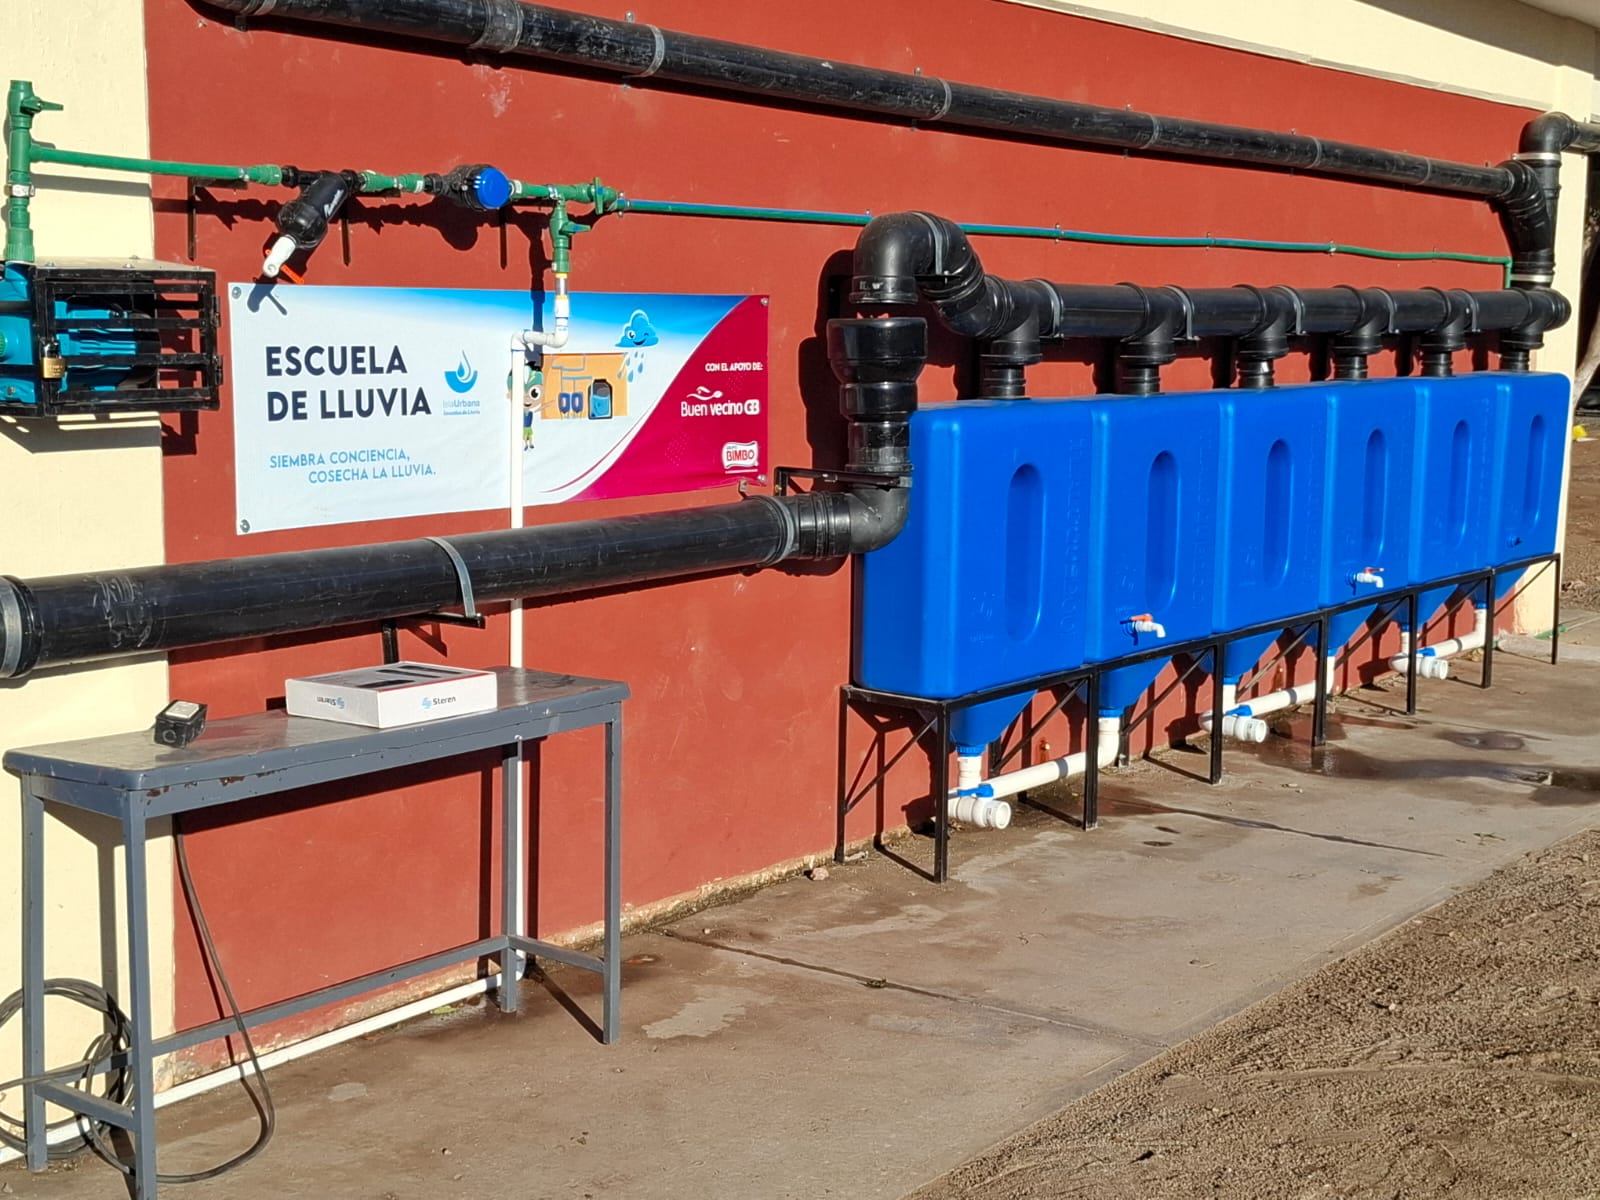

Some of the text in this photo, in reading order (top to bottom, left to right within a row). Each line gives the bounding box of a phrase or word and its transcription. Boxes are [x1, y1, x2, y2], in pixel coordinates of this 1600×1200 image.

[265, 345, 408, 377] ESCUELA
[705, 363, 720, 372] CON
[721, 363, 729, 372] EL
[729, 362, 752, 371] APOYO
[267, 387, 432, 422] DE LLUVIA
[680, 401, 707, 417] Buen
[709, 400, 743, 416] vecino
[270, 448, 411, 469] SIEMBRA CONCIENCIA,
[726, 449, 755, 461] BIMBO
[308, 464, 437, 484] COSECHA LA LLUVIA.
[432, 696, 456, 706] Steren
